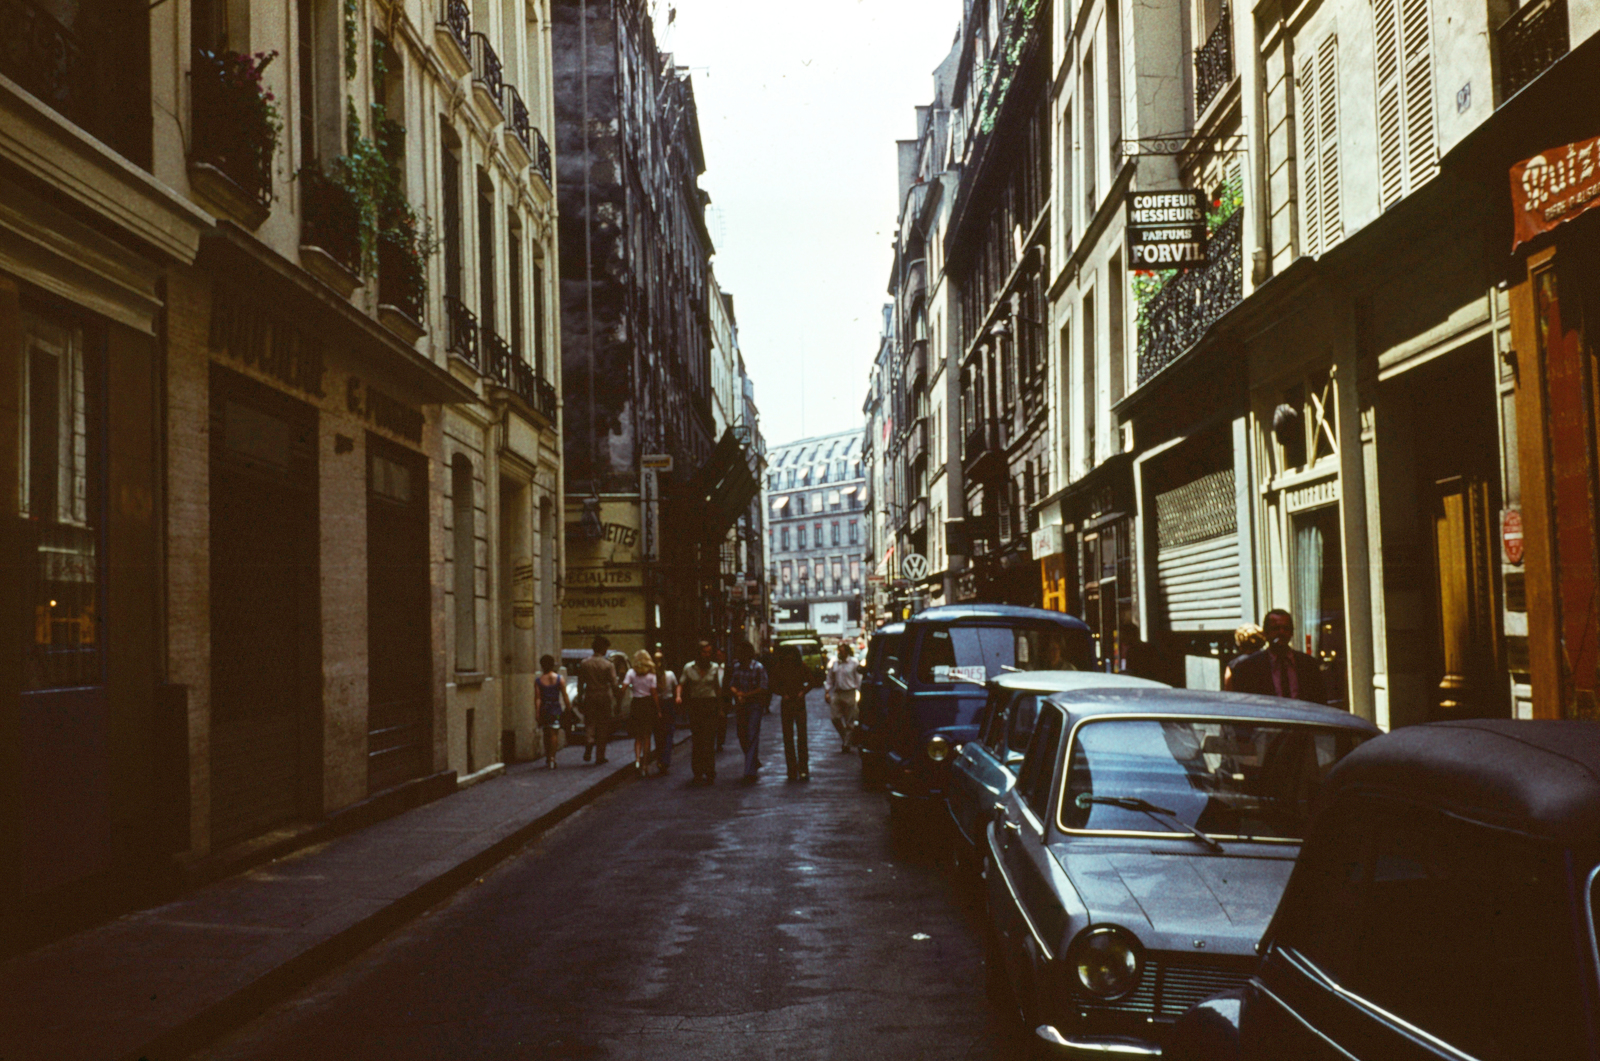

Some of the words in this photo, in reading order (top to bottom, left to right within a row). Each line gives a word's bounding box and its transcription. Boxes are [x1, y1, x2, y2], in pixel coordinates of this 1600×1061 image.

[1133, 194, 1197, 209] COIFFEUR
[1130, 208, 1202, 223] MESSIEURS
[1142, 229, 1193, 241] PARFUMS
[1131, 243, 1205, 264] FORVIL
[1292, 481, 1336, 507] COIFFURE
